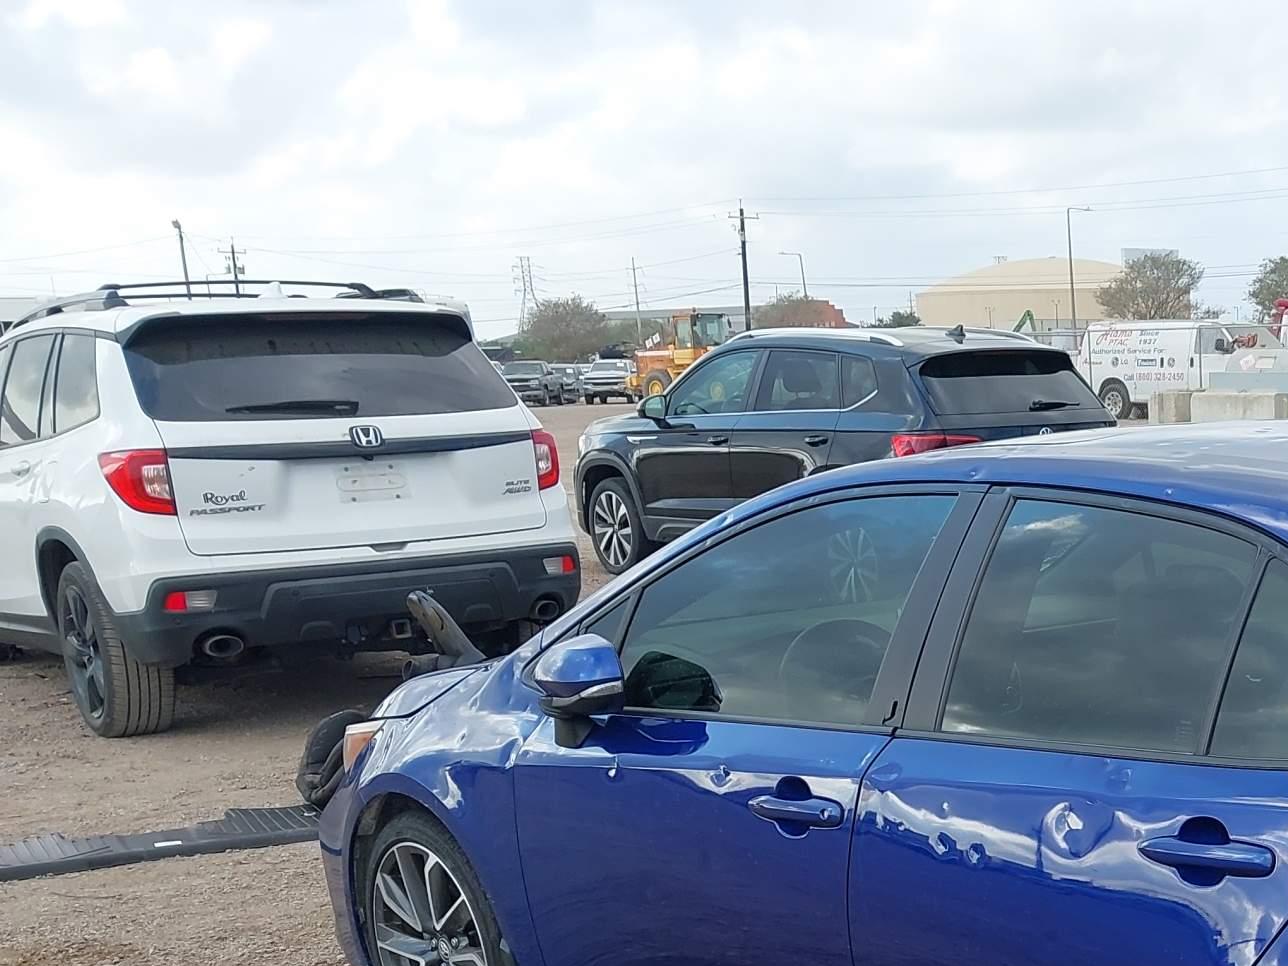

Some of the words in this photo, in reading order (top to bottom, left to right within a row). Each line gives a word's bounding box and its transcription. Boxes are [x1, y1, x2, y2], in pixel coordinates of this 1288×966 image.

[1091, 347, 1126, 355] Authorized
[1127, 347, 1152, 355] Service
[1123, 373, 1135, 381] Call
[501, 486, 532, 496] AWD
[202, 490, 248, 506] Royal
[189, 504, 266, 517] PASSPORT
